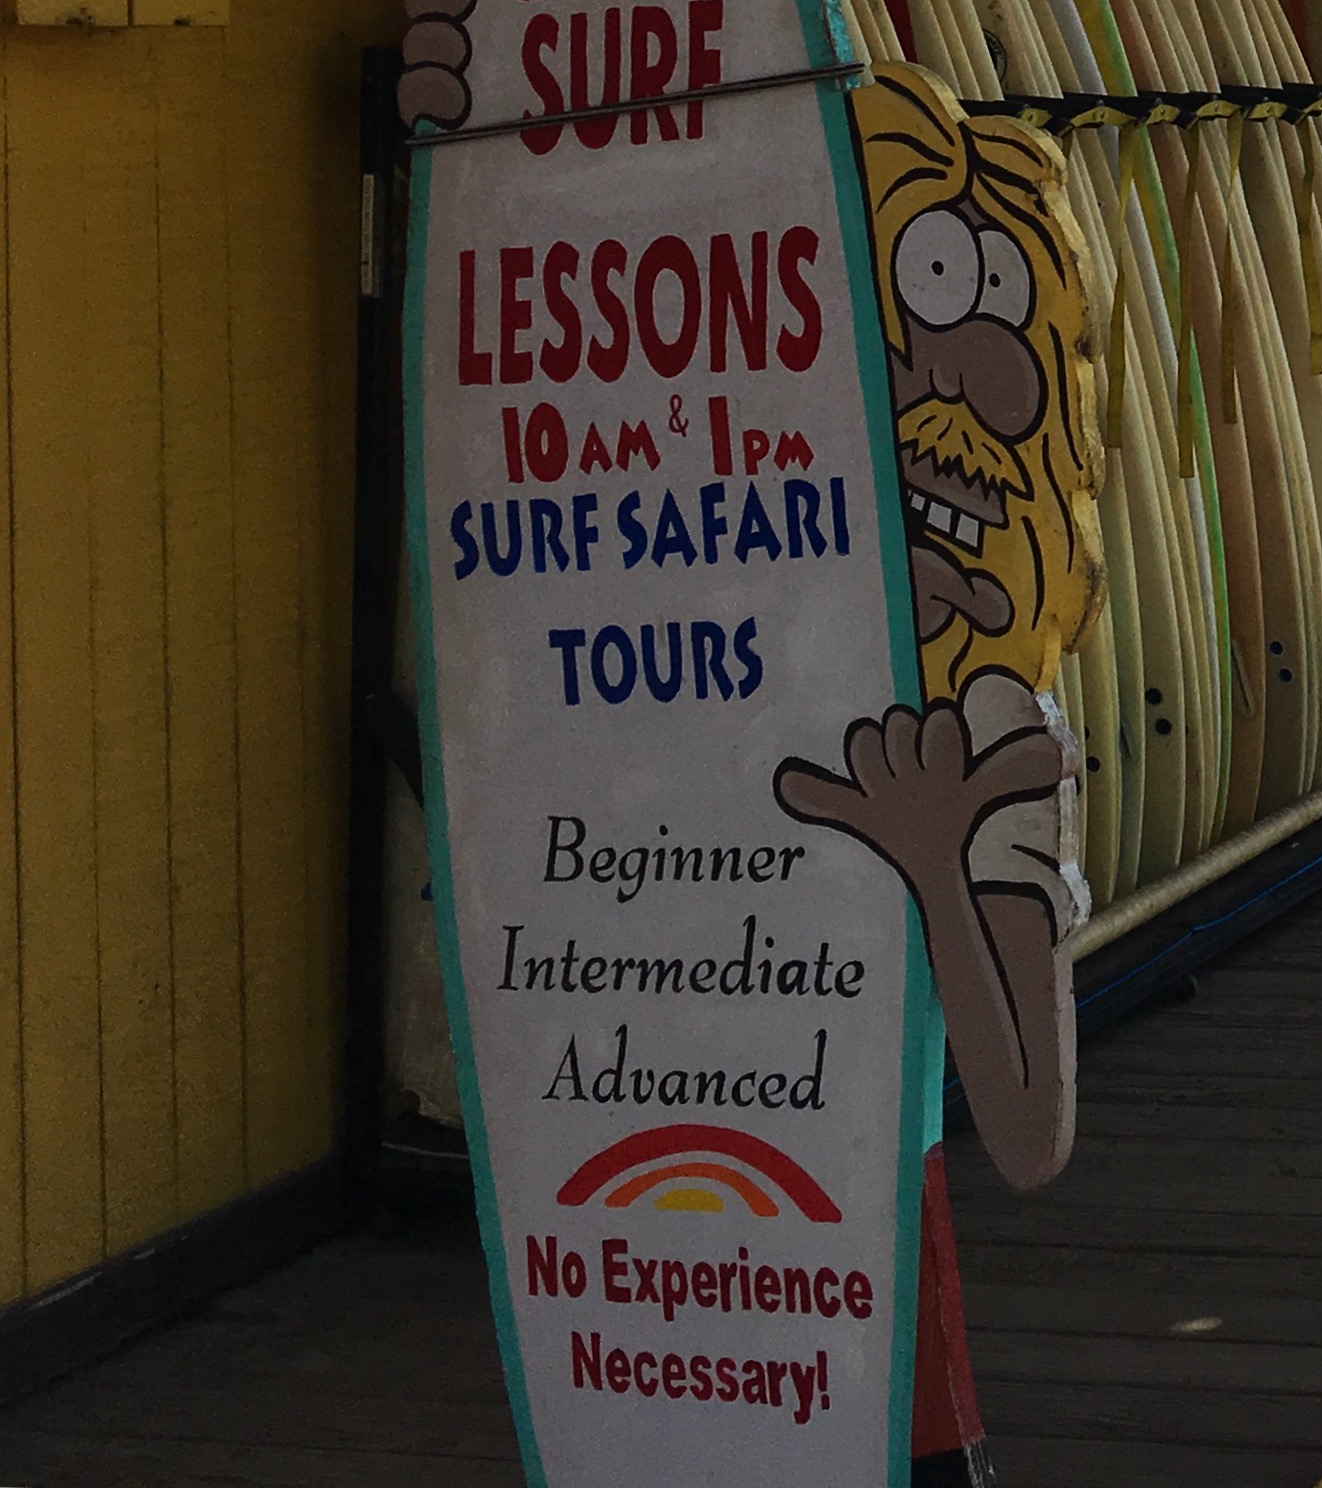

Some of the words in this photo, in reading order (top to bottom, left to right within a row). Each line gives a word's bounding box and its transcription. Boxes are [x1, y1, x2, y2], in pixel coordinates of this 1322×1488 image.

[458, 225, 822, 386] LESSONS
[668, 393, 690, 438] &
[449, 492, 600, 581] SURF
[617, 476, 850, 570] SAFARI
[549, 616, 764, 706] TOURS
[542, 815, 805, 903] Beginner
[497, 914, 865, 998] Intermediate
[541, 1024, 829, 1111] Advanced
[526, 1234, 587, 1299] No
[601, 1238, 873, 1322] Experience
[570, 1330, 831, 1425] Necessary!
